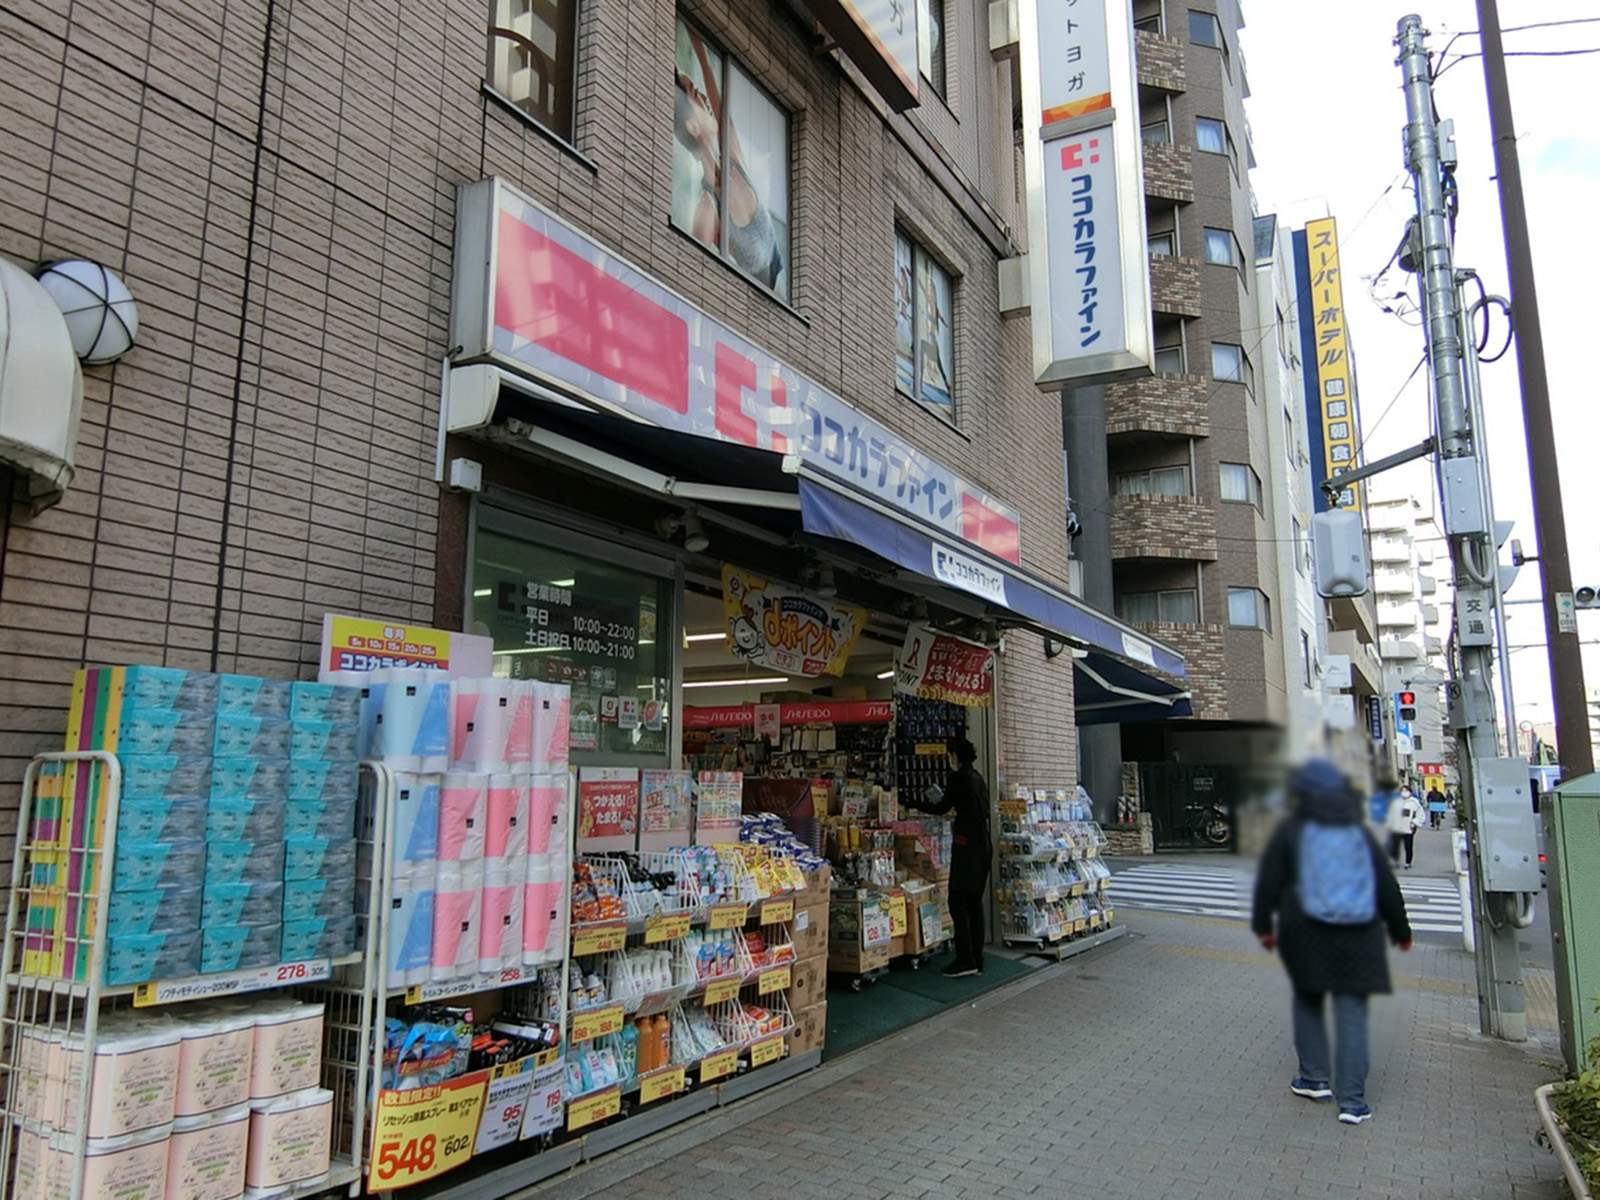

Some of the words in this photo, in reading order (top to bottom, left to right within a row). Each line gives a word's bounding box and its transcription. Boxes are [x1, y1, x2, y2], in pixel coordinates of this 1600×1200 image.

[1071, 174, 1101, 348] ココカラファイン
[1313, 230, 1343, 367] スーパーホテル
[800, 401, 954, 520] ココカラファイン
[955, 560, 1001, 593] ココカラファイン
[526, 581, 573, 607] 営業時間
[526, 606, 549, 626] 平日
[1466, 598, 1485, 635] 交通
[383, 625, 406, 640] 毎月
[525, 628, 570, 648] 土日祝日
[710, 712, 752, 722] SHISEIDO
[785, 708, 831, 720] SHISEIDO
[277, 964, 306, 981] 278
[501, 1103, 522, 1122] 95
[378, 1133, 437, 1180] 548
[444, 1134, 469, 1157] 602
